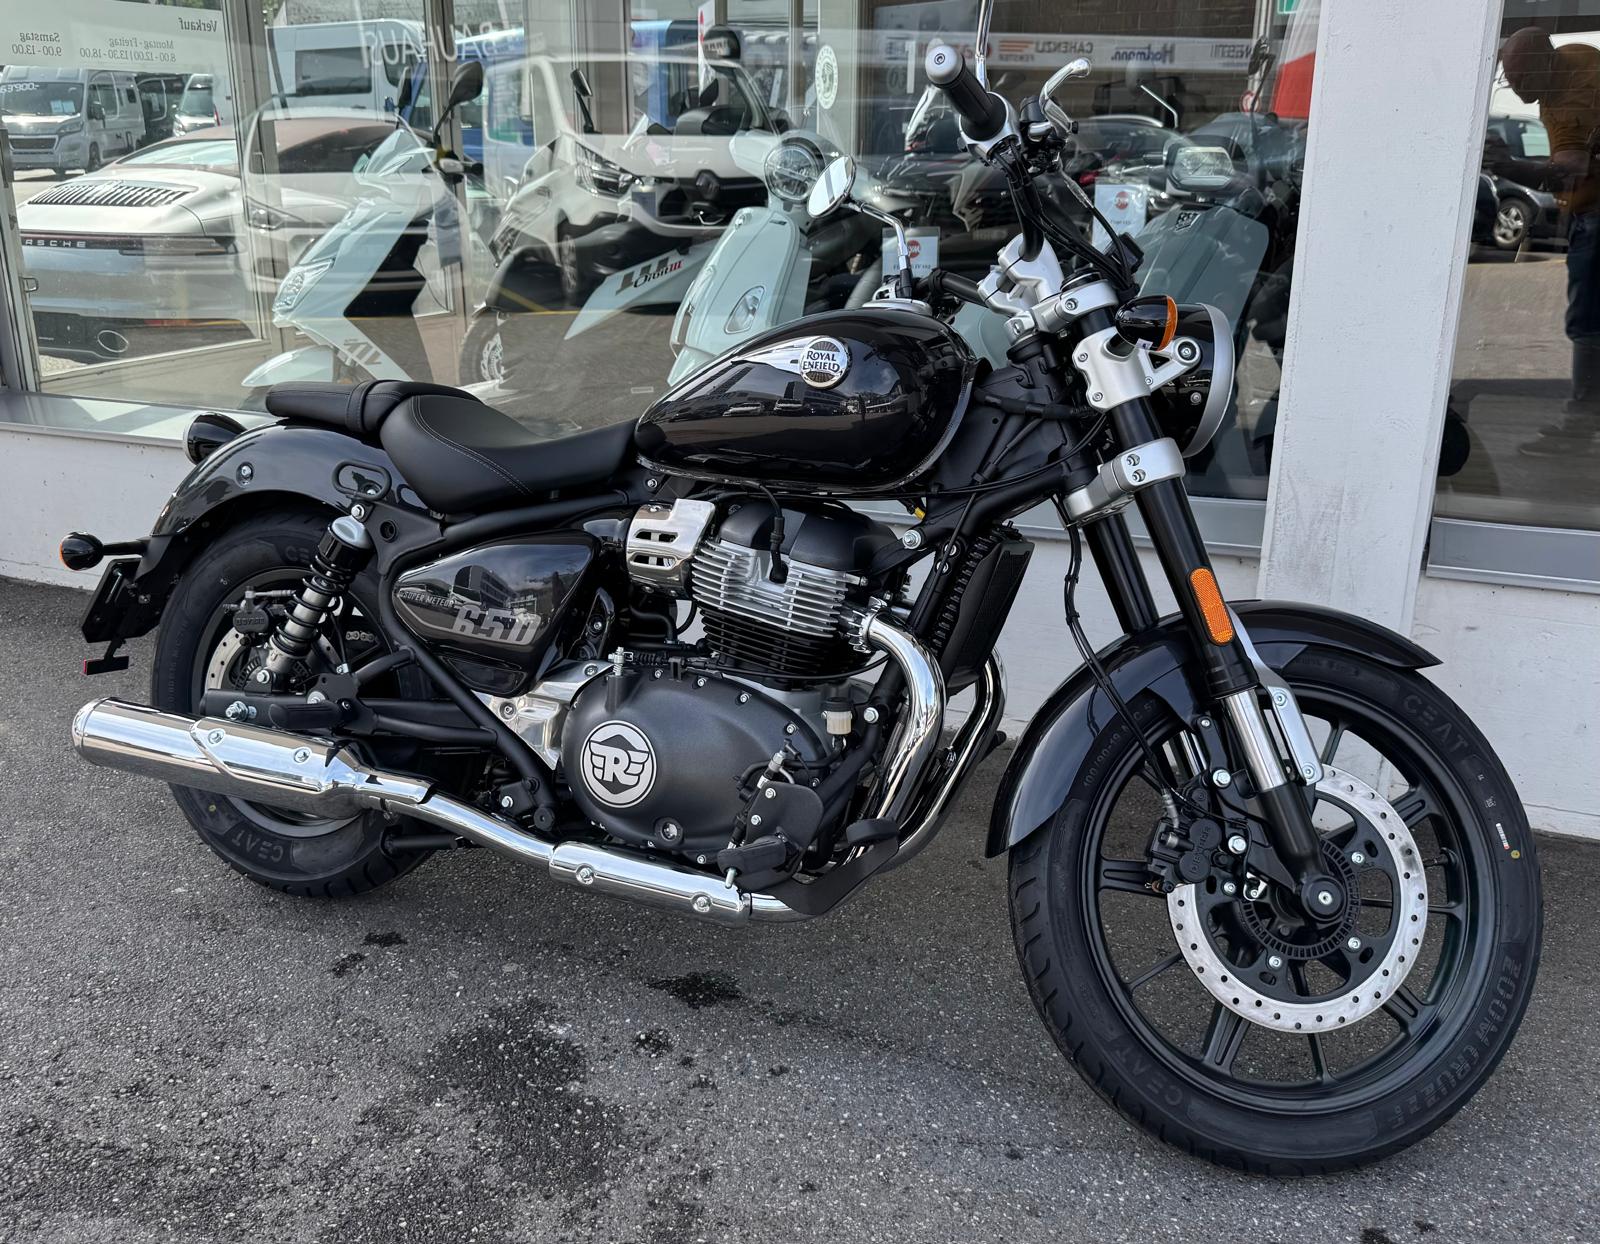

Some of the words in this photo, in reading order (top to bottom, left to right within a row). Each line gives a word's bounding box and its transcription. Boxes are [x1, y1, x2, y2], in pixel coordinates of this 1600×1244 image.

[25, 239, 87, 249] RSCHE
[802, 361, 840, 373] ENFIELD
[806, 350, 837, 362] ROYAL
[403, 591, 425, 602] SUPER
[426, 595, 454, 608] METEOR
[451, 604, 542, 645] 650
[1404, 695, 1469, 751] CEAT
[231, 829, 284, 862] CEAT
[1475, 955, 1522, 1046] ZOOM
[1115, 1048, 1183, 1105] CEAT
